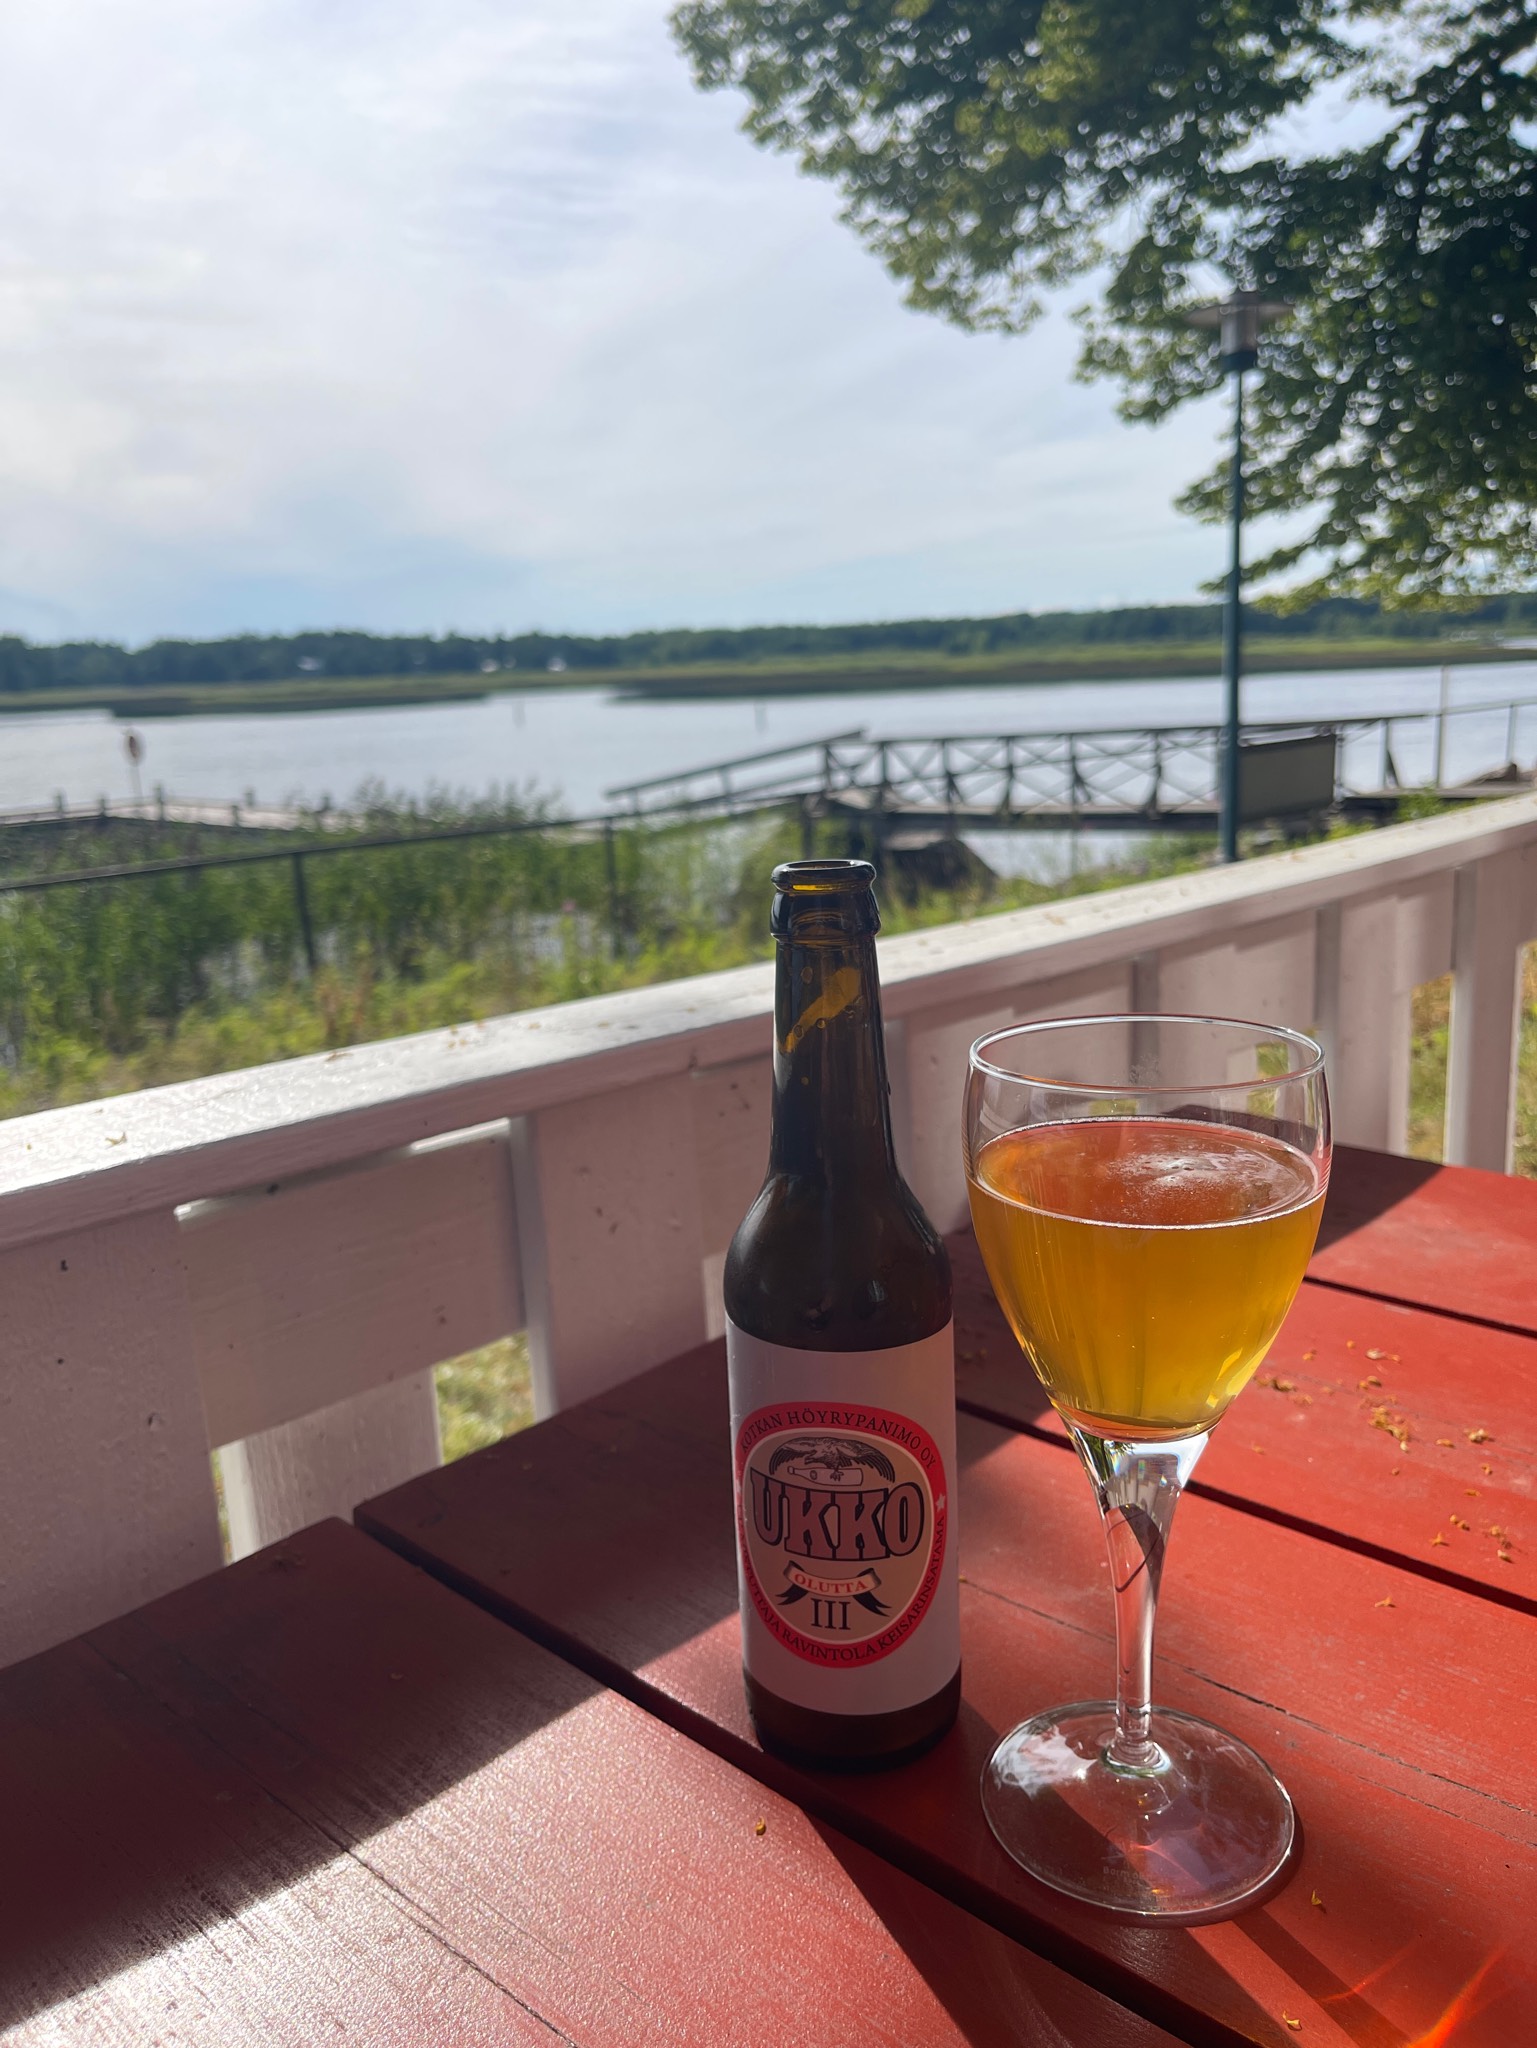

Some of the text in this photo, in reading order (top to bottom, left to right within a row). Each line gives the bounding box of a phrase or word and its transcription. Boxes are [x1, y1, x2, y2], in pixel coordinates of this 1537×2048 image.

[740, 1407, 937, 1469] KOTKAN HÖYRYPANIMO OY
[750, 1466, 925, 1562] UKKO
[782, 1630, 878, 1662] RAVINTOLA
[876, 1515, 945, 1651] KEISARINSATAMA
[794, 1573, 870, 1594] OLUTTA
[810, 1598, 851, 1630] III
